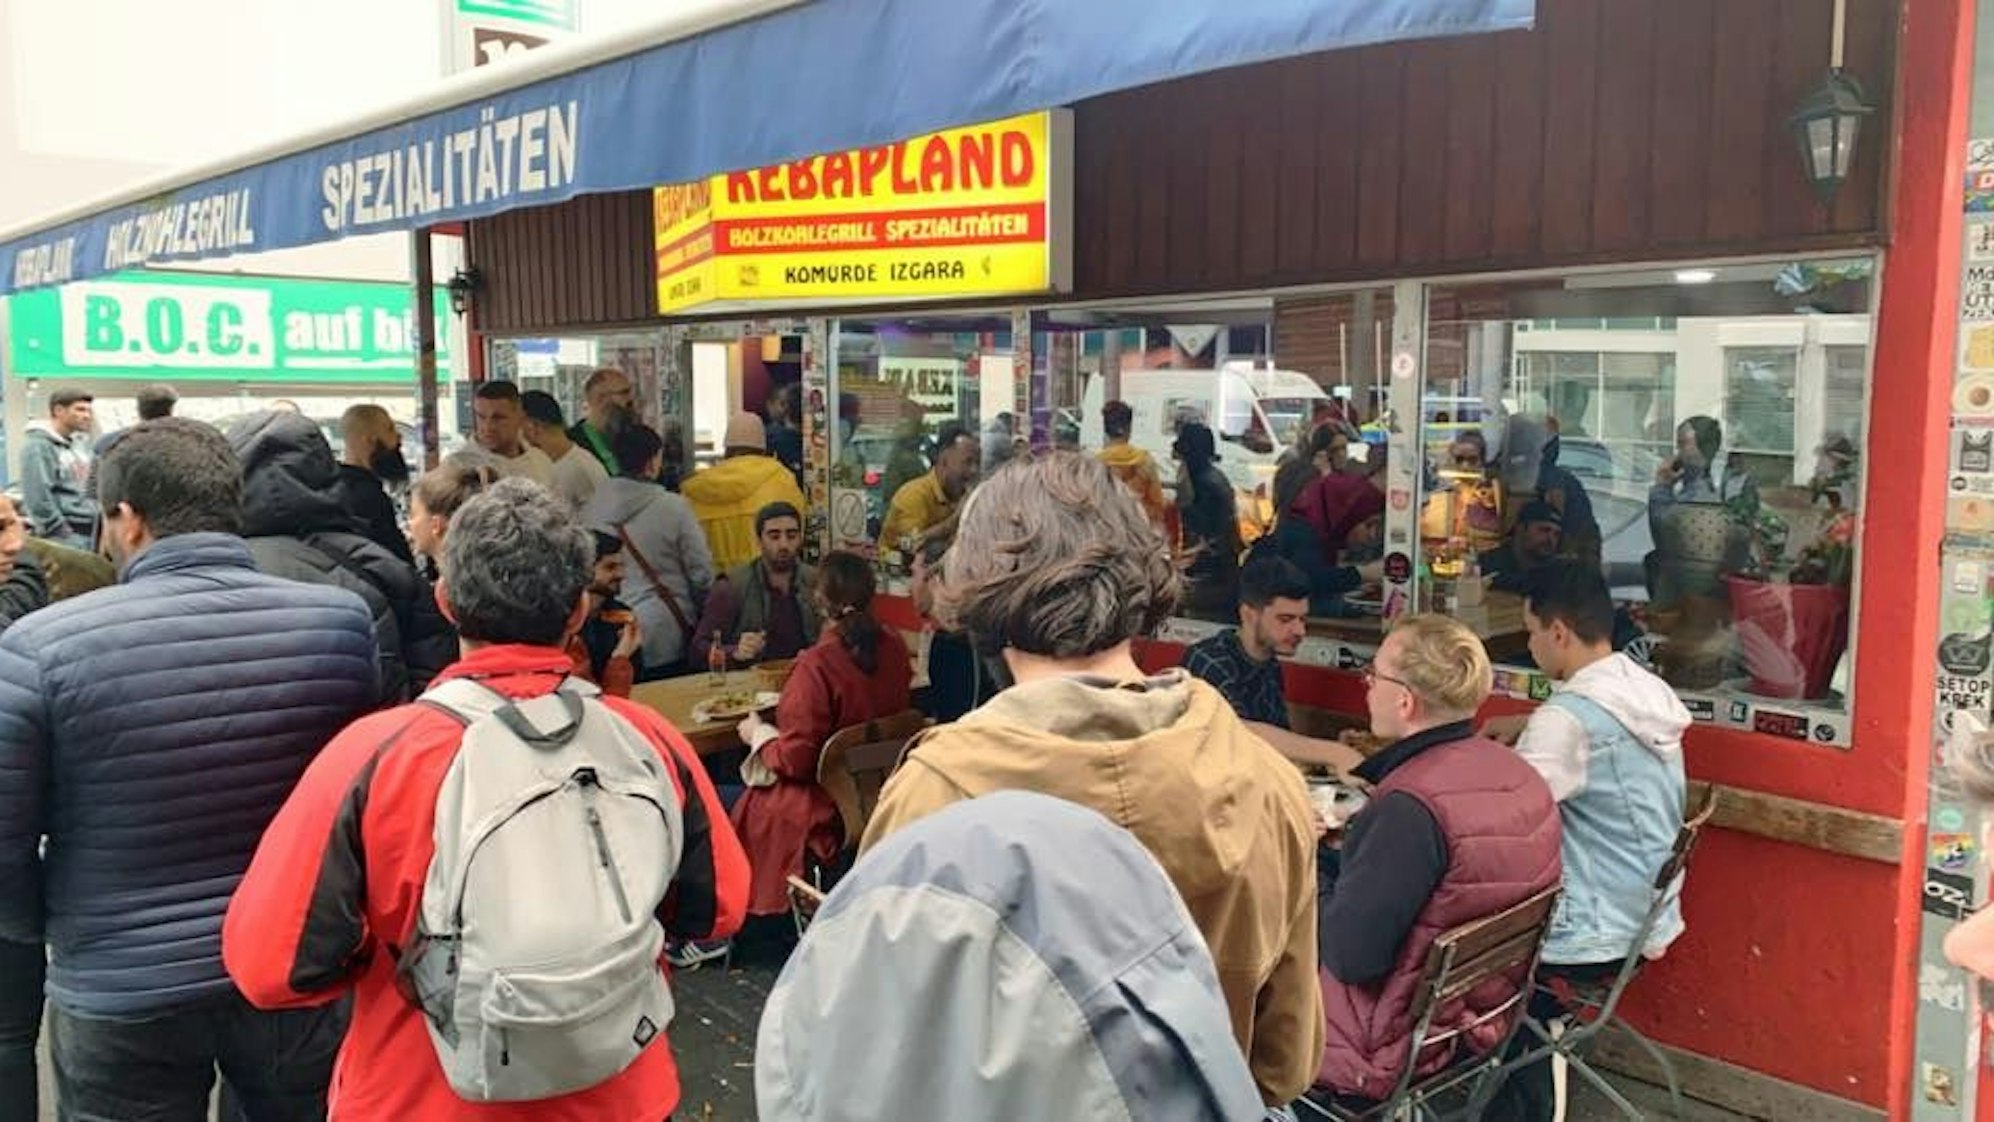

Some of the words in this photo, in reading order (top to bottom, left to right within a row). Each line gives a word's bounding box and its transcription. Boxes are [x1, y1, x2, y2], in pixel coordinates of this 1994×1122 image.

[322, 100, 578, 231] SPEZIALITÄTEN
[729, 222, 877, 248] HOLZKOHLEGRILL
[885, 212, 1029, 241] SPEZIALITÄTEN
[890, 260, 965, 281] IZGARA
[84, 294, 260, 356] B.O.C.
[283, 305, 363, 352] auf
